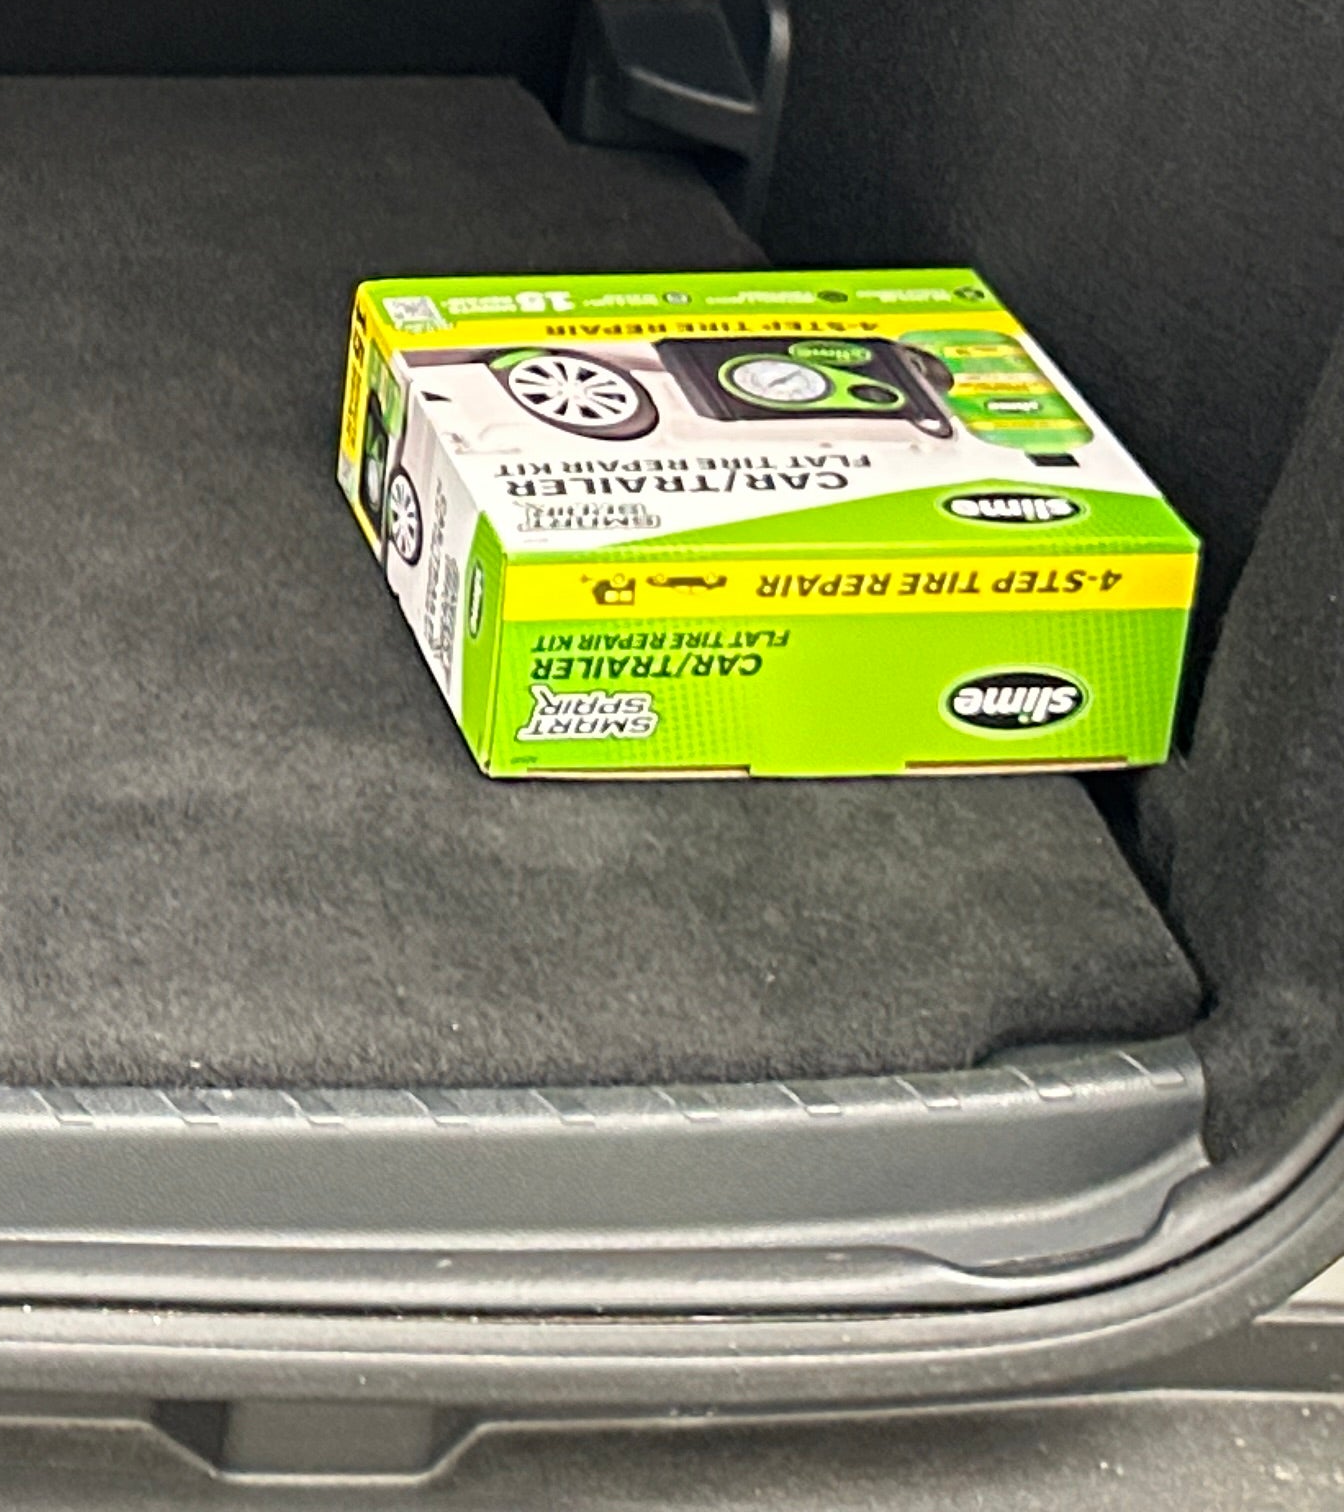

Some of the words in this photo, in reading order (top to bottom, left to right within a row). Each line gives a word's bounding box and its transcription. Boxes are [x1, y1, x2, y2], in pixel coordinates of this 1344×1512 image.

[545, 322, 667, 337] REPAIR
[676, 321, 754, 334] TIRE
[494, 461, 552, 478] KIT
[561, 457, 690, 474] REPAIR
[696, 455, 770, 471] TIRE
[785, 453, 873, 469] FLAT
[506, 469, 849, 497] CAR/TRAILER
[950, 498, 1074, 521] slime
[755, 571, 892, 598] REPAIR
[898, 569, 981, 596] TIRE
[991, 568, 1123, 594] 4-STEP
[530, 634, 574, 653] KIT
[577, 631, 668, 651] REPAIR
[669, 630, 726, 649] TIRE
[727, 629, 791, 648] FLAT
[530, 652, 763, 680] CAR/TRAILER
[952, 686, 1078, 724] slime
[530, 714, 654, 736] SMART
